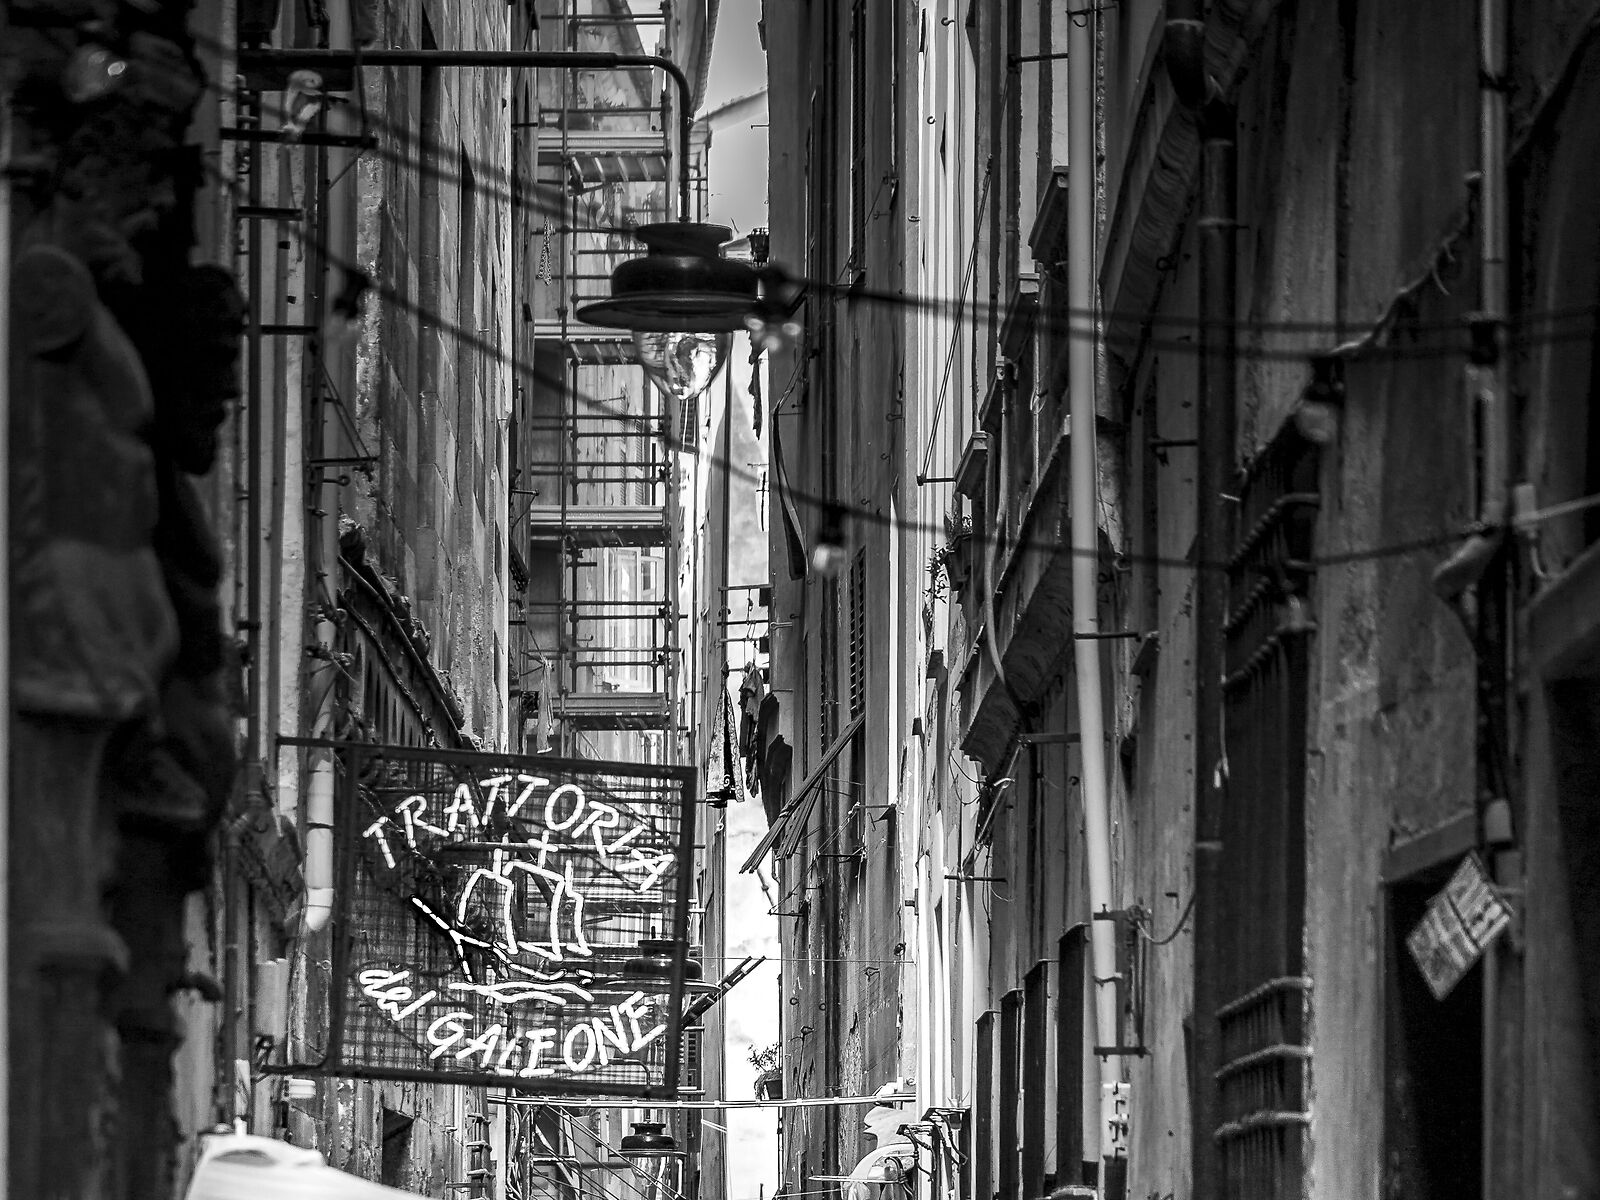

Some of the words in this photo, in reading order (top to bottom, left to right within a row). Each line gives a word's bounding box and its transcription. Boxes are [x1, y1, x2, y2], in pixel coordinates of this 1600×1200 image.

[362, 774, 676, 893] TRATTORIA
[359, 967, 437, 1022] del
[426, 990, 668, 1078] GALEONE
